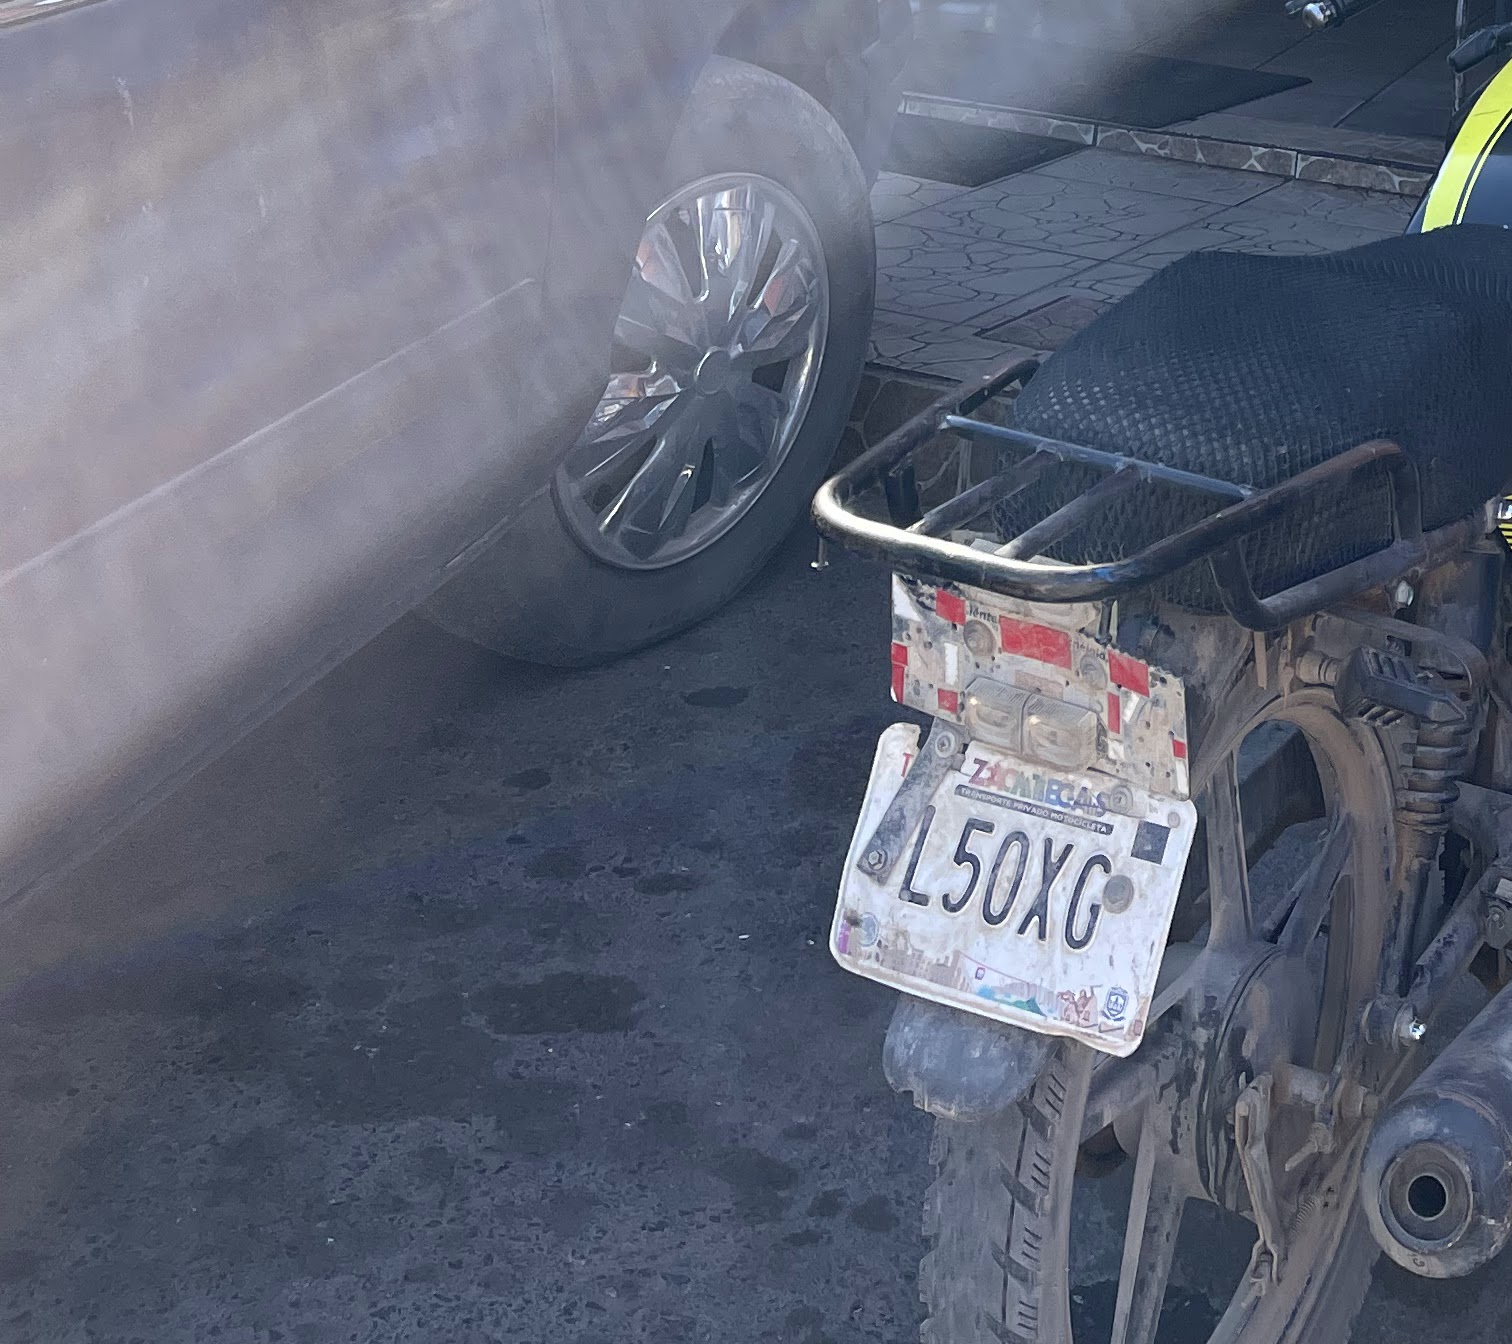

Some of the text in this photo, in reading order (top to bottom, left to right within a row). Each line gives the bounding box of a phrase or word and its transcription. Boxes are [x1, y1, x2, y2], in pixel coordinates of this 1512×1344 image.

[961, 787, 1107, 833] TRANSPORTE PRIVADO MOTOCICLETA
[899, 805, 1112, 950] L50XG
